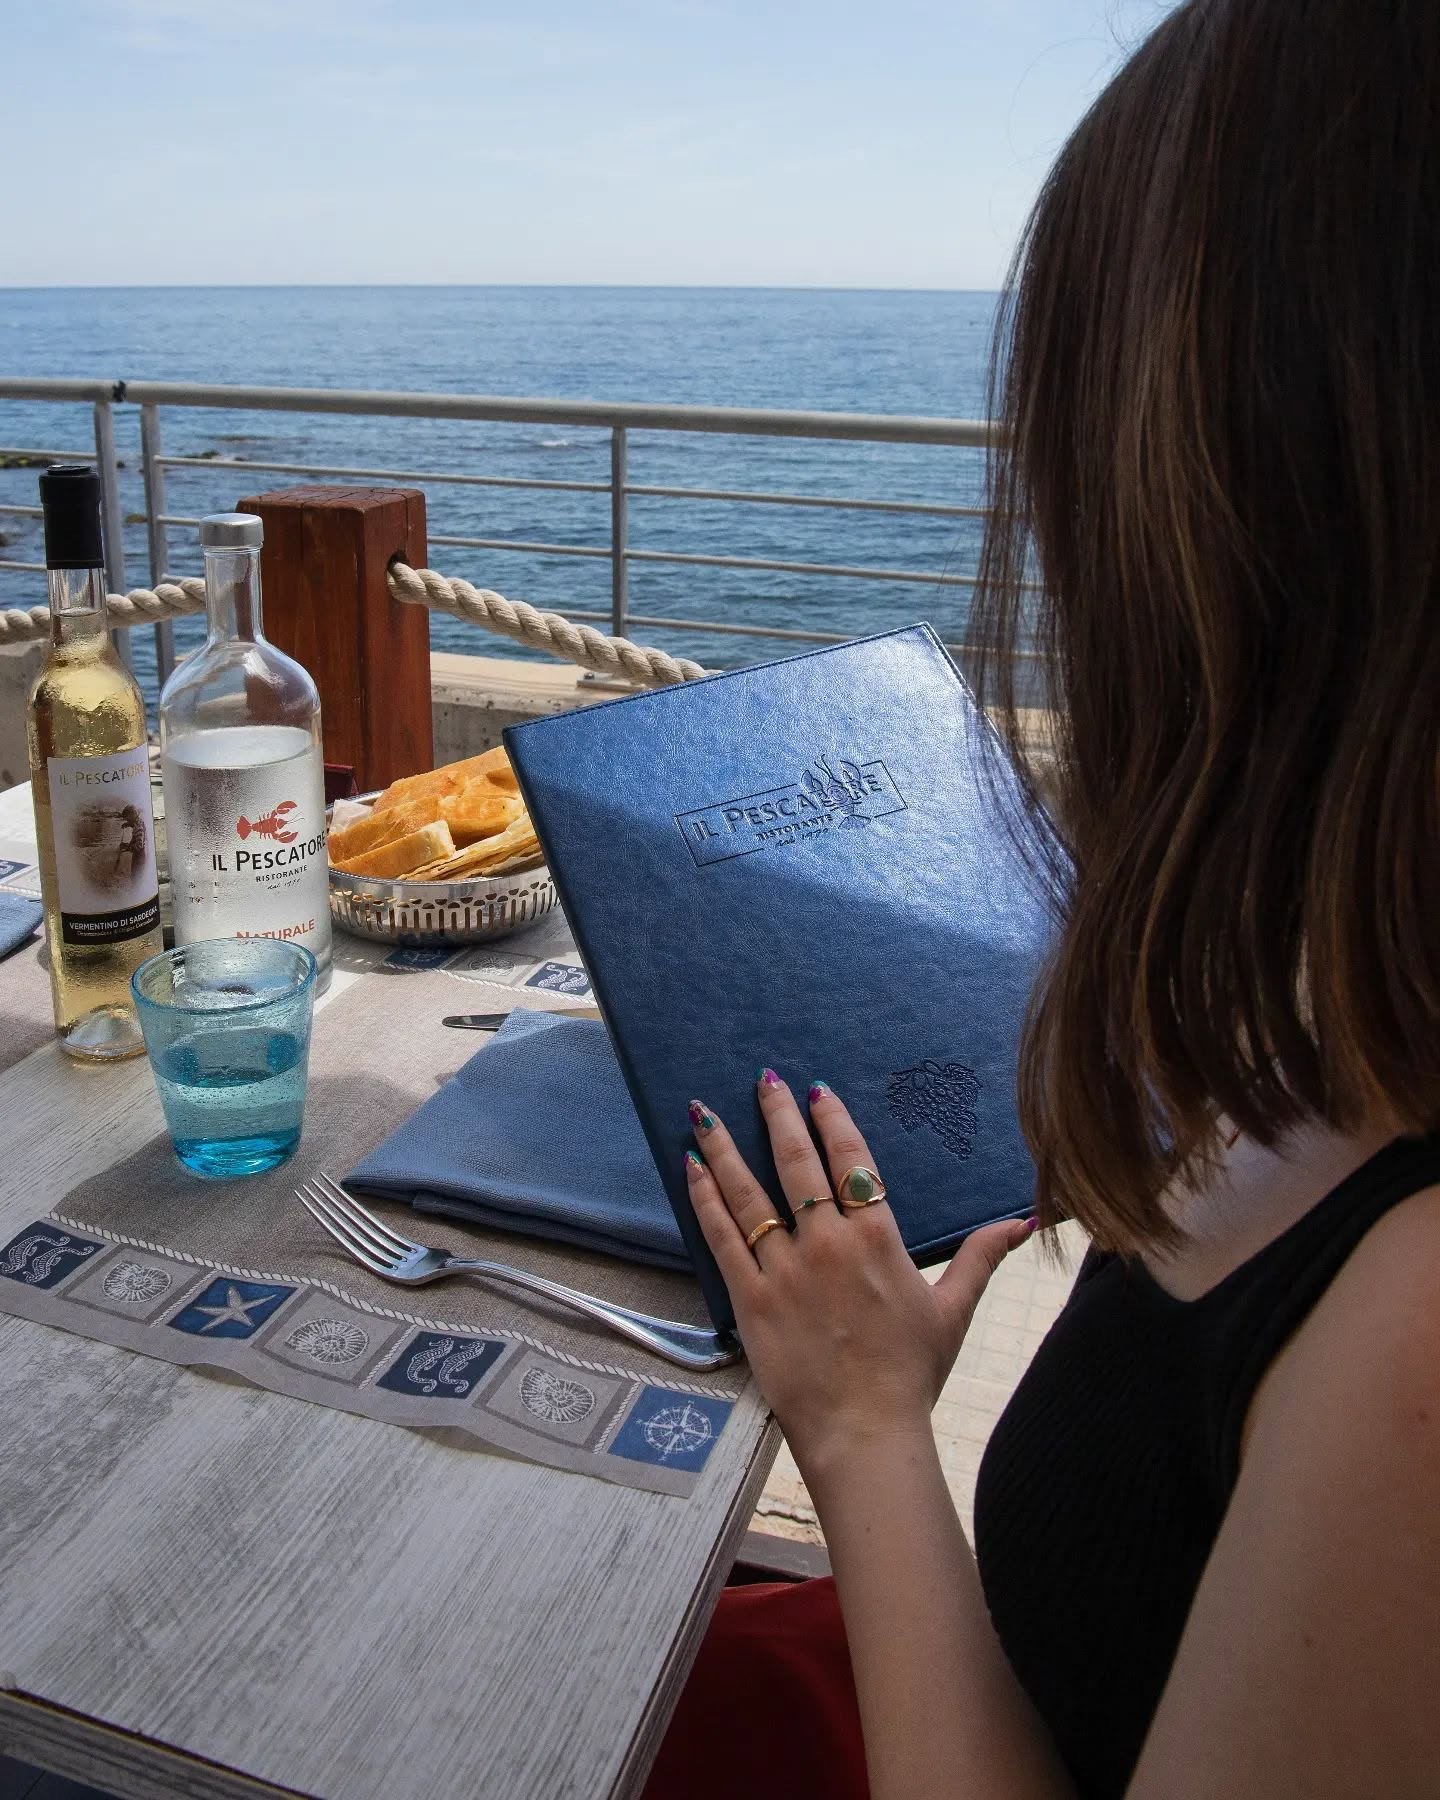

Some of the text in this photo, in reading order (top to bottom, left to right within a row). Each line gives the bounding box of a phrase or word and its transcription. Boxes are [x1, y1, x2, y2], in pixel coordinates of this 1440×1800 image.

[59, 761, 145, 786] IL PESCATORE
[692, 820, 720, 841] IL
[755, 813, 834, 841] RISTORANTE
[212, 831, 326, 872] IL PESCATORE
[255, 864, 308, 883] RISTORANTE
[69, 920, 119, 931] VERMENTINO
[120, 918, 129, 927] DI
